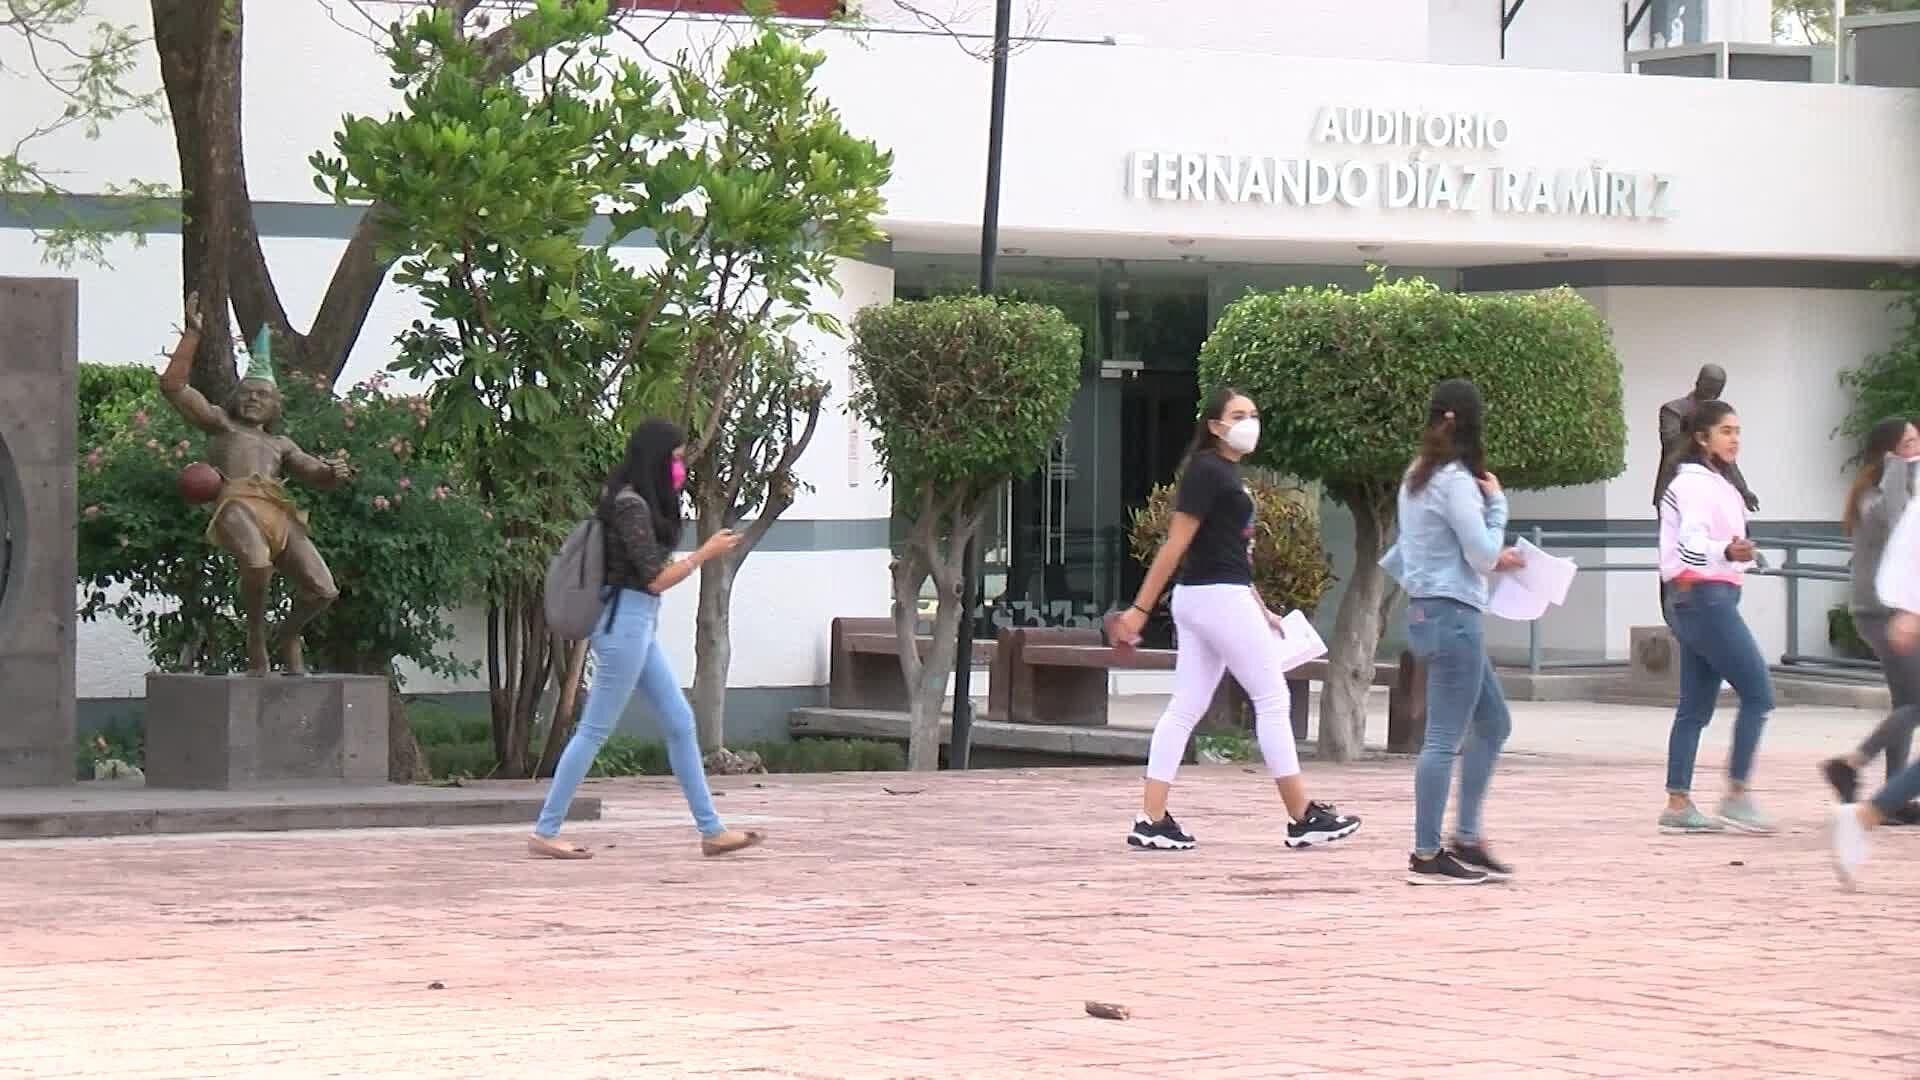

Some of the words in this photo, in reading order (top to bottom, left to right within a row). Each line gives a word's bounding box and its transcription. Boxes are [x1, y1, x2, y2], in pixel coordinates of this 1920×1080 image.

[1312, 104, 1512, 149] AUDITORIO
[1129, 150, 1376, 208] FERNANDO
[1383, 149, 1481, 211] DÍAZ
